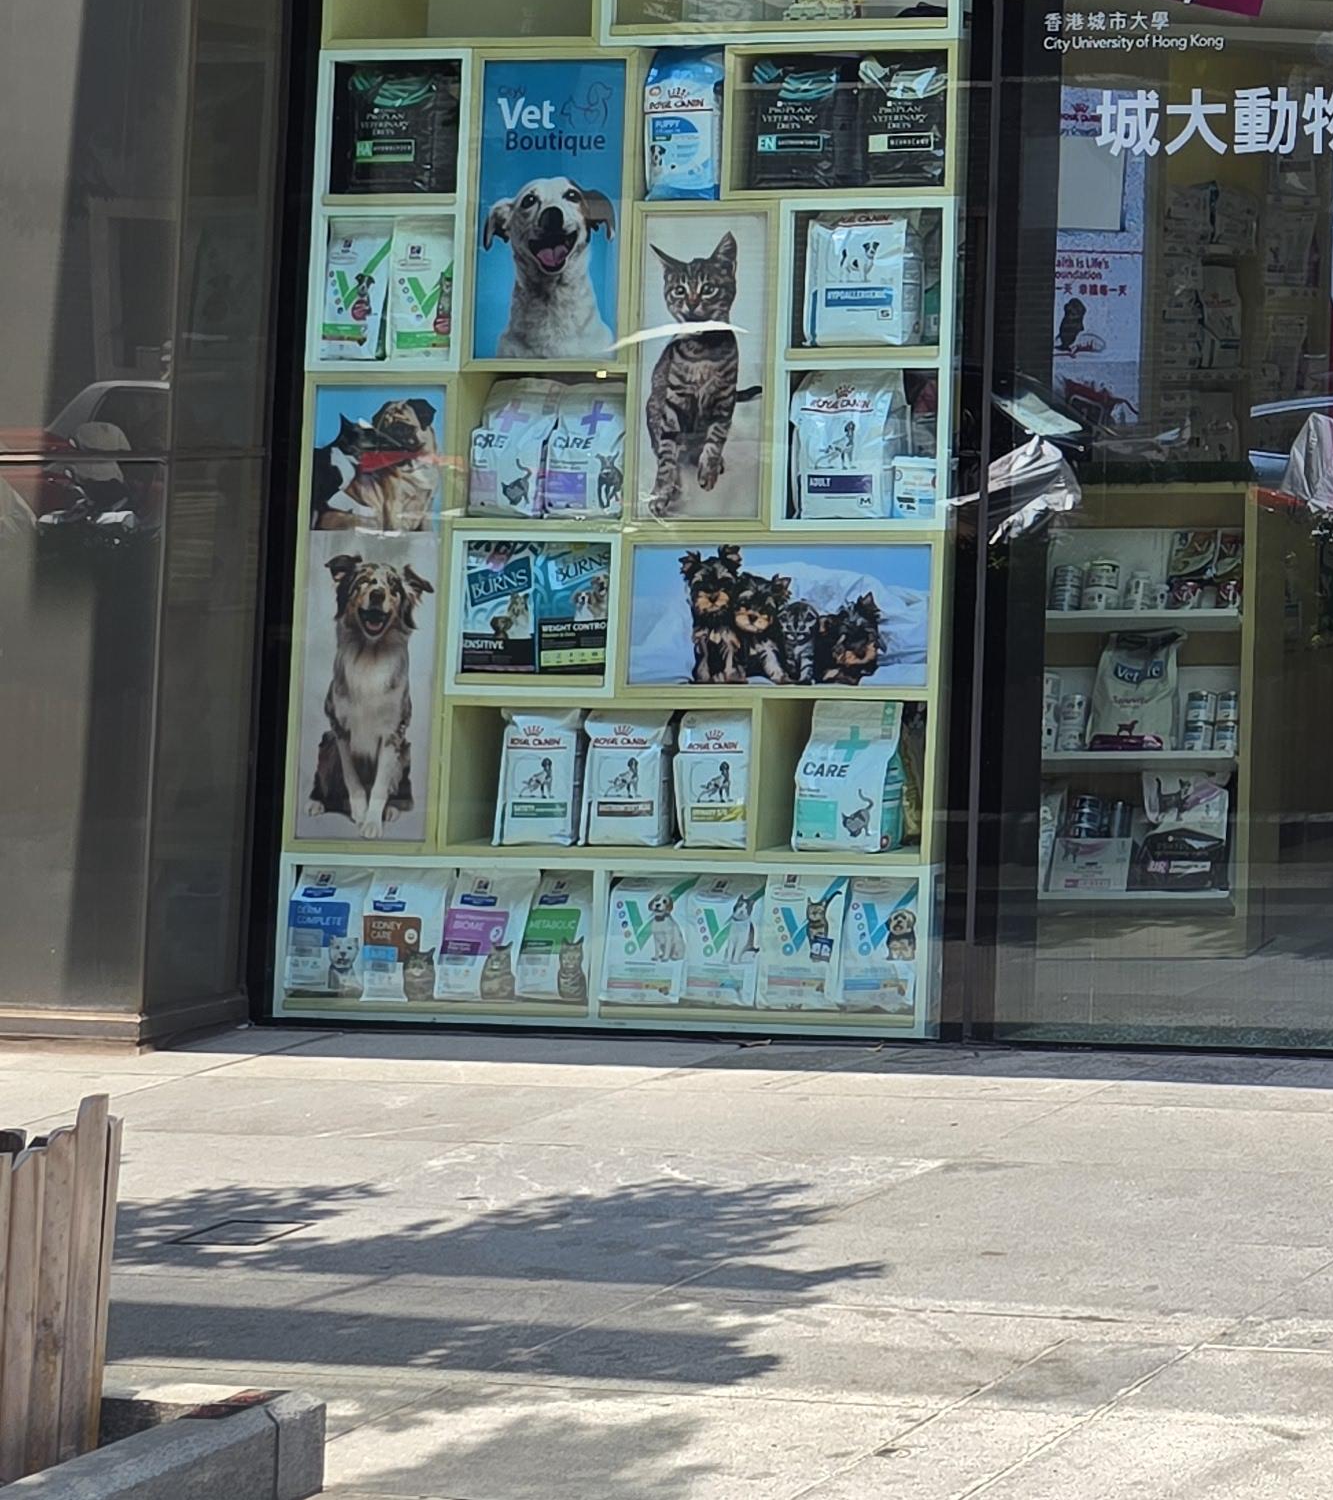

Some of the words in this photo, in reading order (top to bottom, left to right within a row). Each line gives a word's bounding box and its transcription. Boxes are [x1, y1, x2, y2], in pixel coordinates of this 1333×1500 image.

[1044, 11, 1169, 32] 香港城市大學
[1044, 36, 1071, 54] City
[1072, 35, 1134, 52] University
[1135, 36, 1150, 50] of
[1152, 35, 1188, 51] Hong
[1189, 33, 1225, 51] Kong
[497, 96, 556, 130] Vet
[505, 130, 606, 157] Boutique
[760, 136, 774, 150] EN
[1055, 270, 1103, 280] oundation
[471, 568, 529, 599] BURNS
[573, 622, 607, 631] CONTRO
[463, 639, 505, 650] ENSITIVE
[802, 762, 850, 778] CARE
[297, 915, 343, 927] COMPLETE
[371, 921, 402, 932] KIDNEY
[453, 921, 485, 932] BIOME
[529, 920, 577, 931] METABOLIC
[370, 931, 392, 941] CARE
